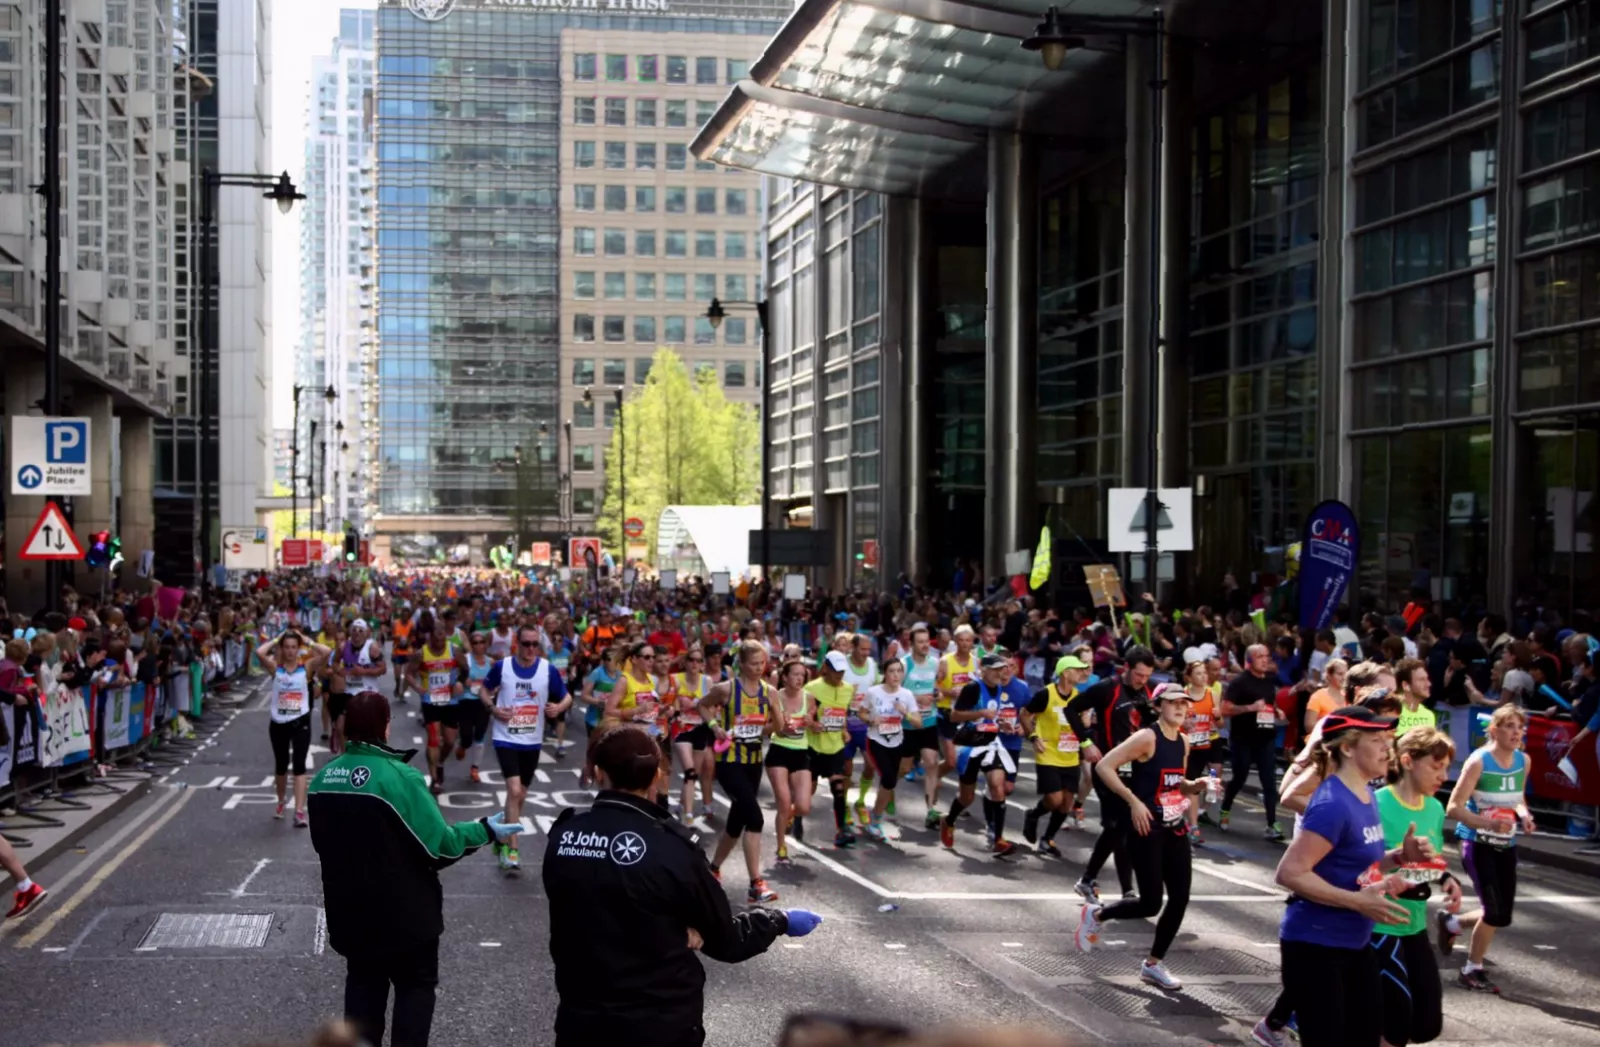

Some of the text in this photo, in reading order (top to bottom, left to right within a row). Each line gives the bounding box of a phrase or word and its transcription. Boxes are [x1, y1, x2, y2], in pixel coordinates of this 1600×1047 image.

[53, 426, 79, 460] P
[46, 467, 85, 475] Jubilee
[515, 682, 532, 690] PHIL
[1400, 716, 1429, 727] SCOTT
[560, 831, 609, 848] St John
[557, 846, 606, 858] Ambulance
